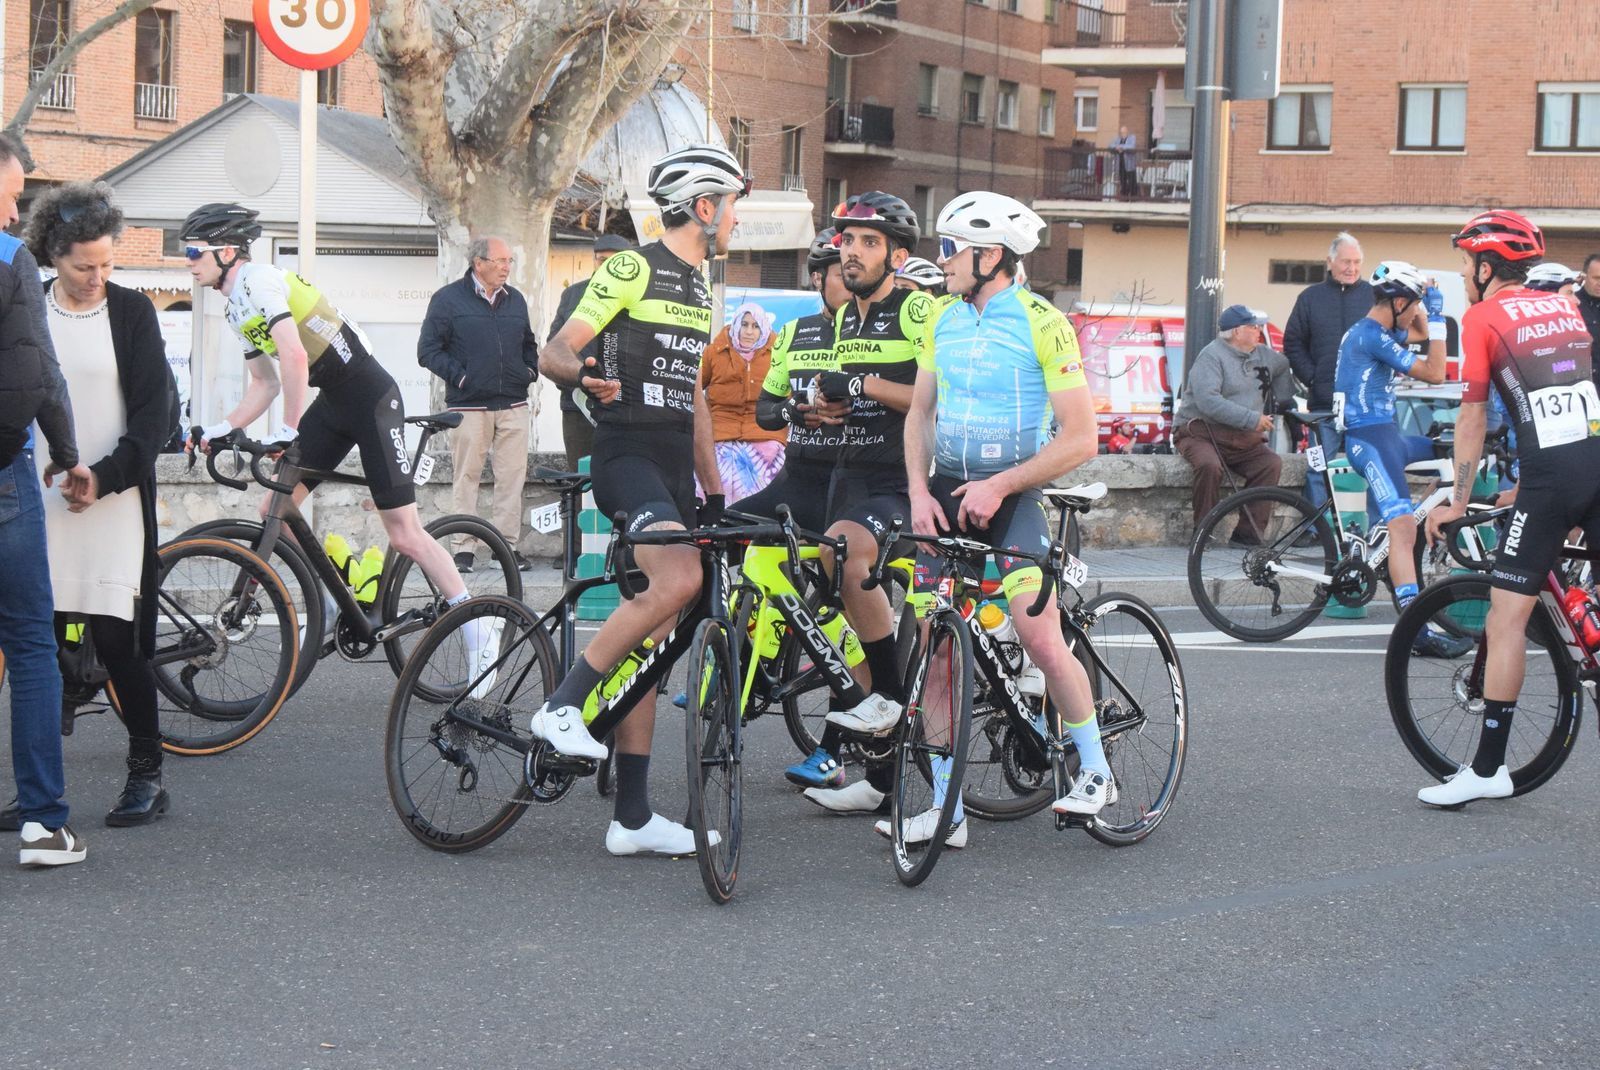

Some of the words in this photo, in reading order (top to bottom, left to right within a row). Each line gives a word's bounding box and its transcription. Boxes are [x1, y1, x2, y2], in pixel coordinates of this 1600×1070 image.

[280, 0, 347, 30] 30
[1502, 296, 1577, 321] FROIZ
[837, 340, 882, 354] OURIÑA
[1535, 392, 1573, 418] 137
[419, 458, 432, 480] 116
[1310, 449, 1321, 468] 244
[536, 510, 558, 529] 151
[1504, 509, 1528, 557] FROIZ
[1066, 562, 1084, 584] 212
[780, 593, 854, 690] DOGMA
